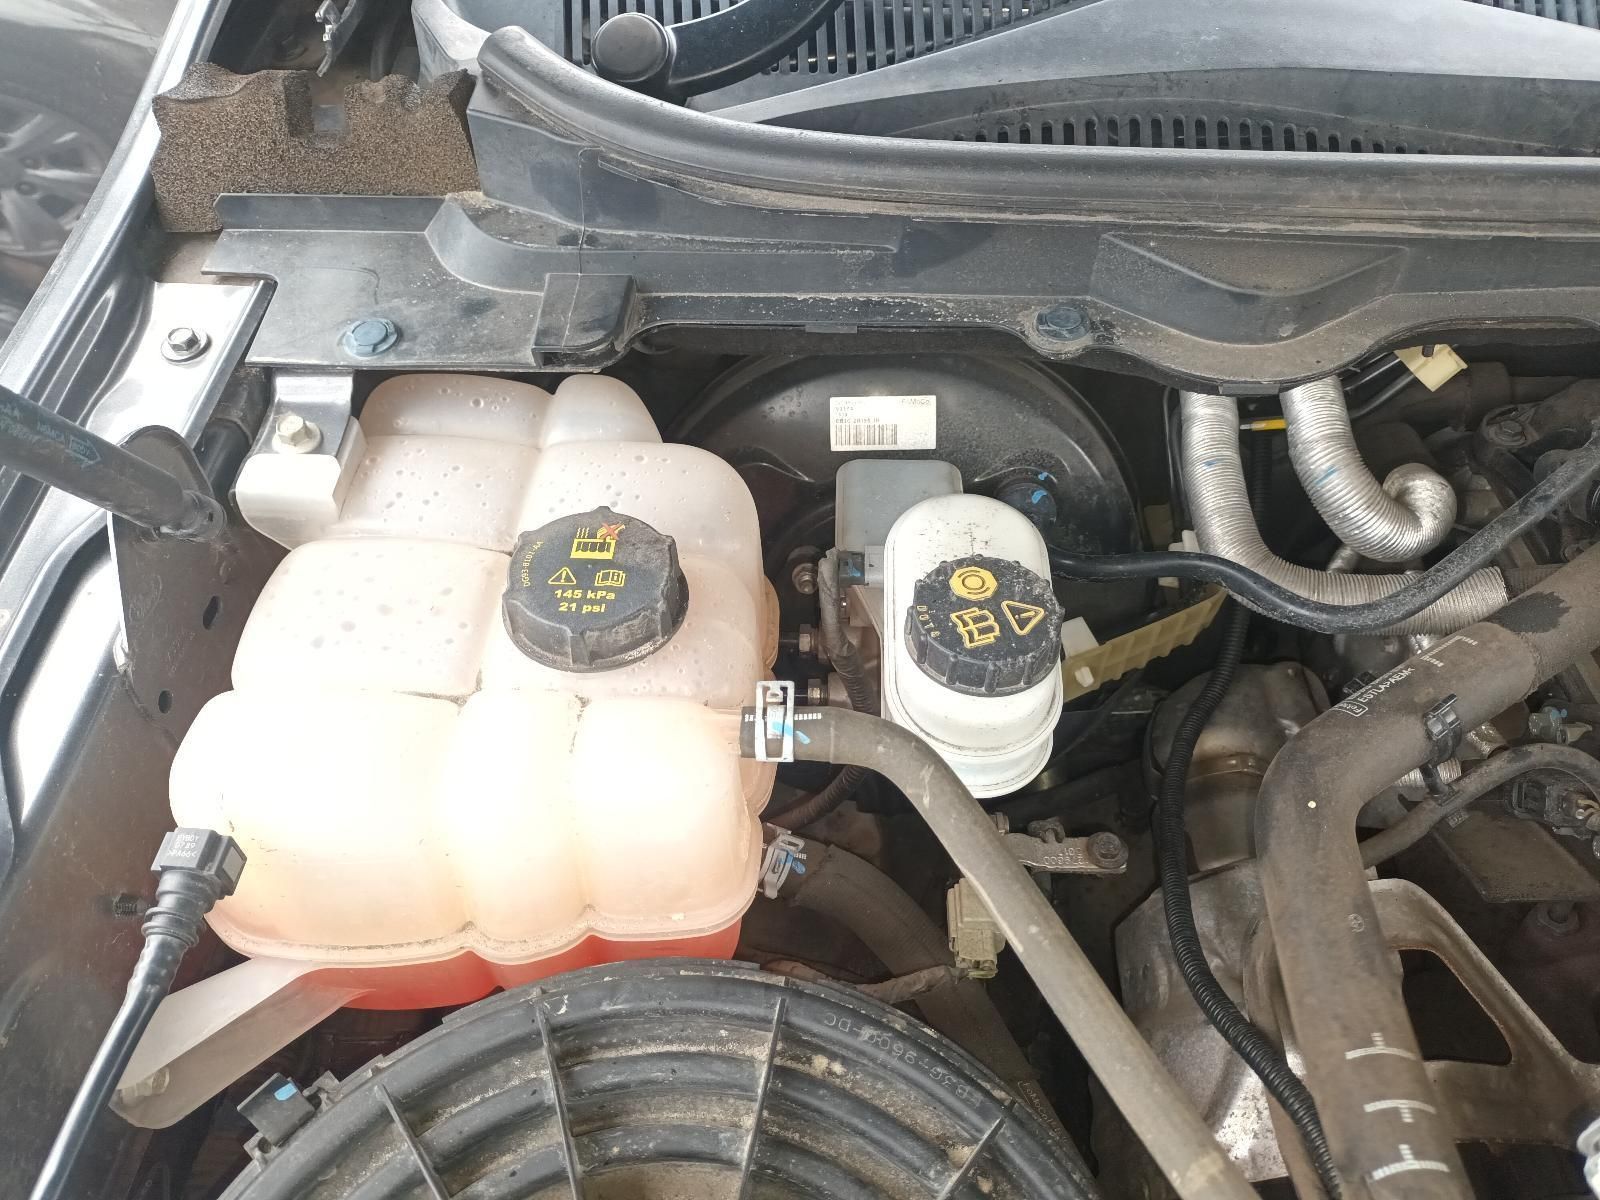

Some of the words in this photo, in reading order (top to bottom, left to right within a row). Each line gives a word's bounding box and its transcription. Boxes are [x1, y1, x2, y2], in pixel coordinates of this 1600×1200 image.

[554, 589, 583, 599] 145
[586, 589, 616, 600] kPa
[558, 602, 577, 612] 21
[581, 603, 606, 614] psi
